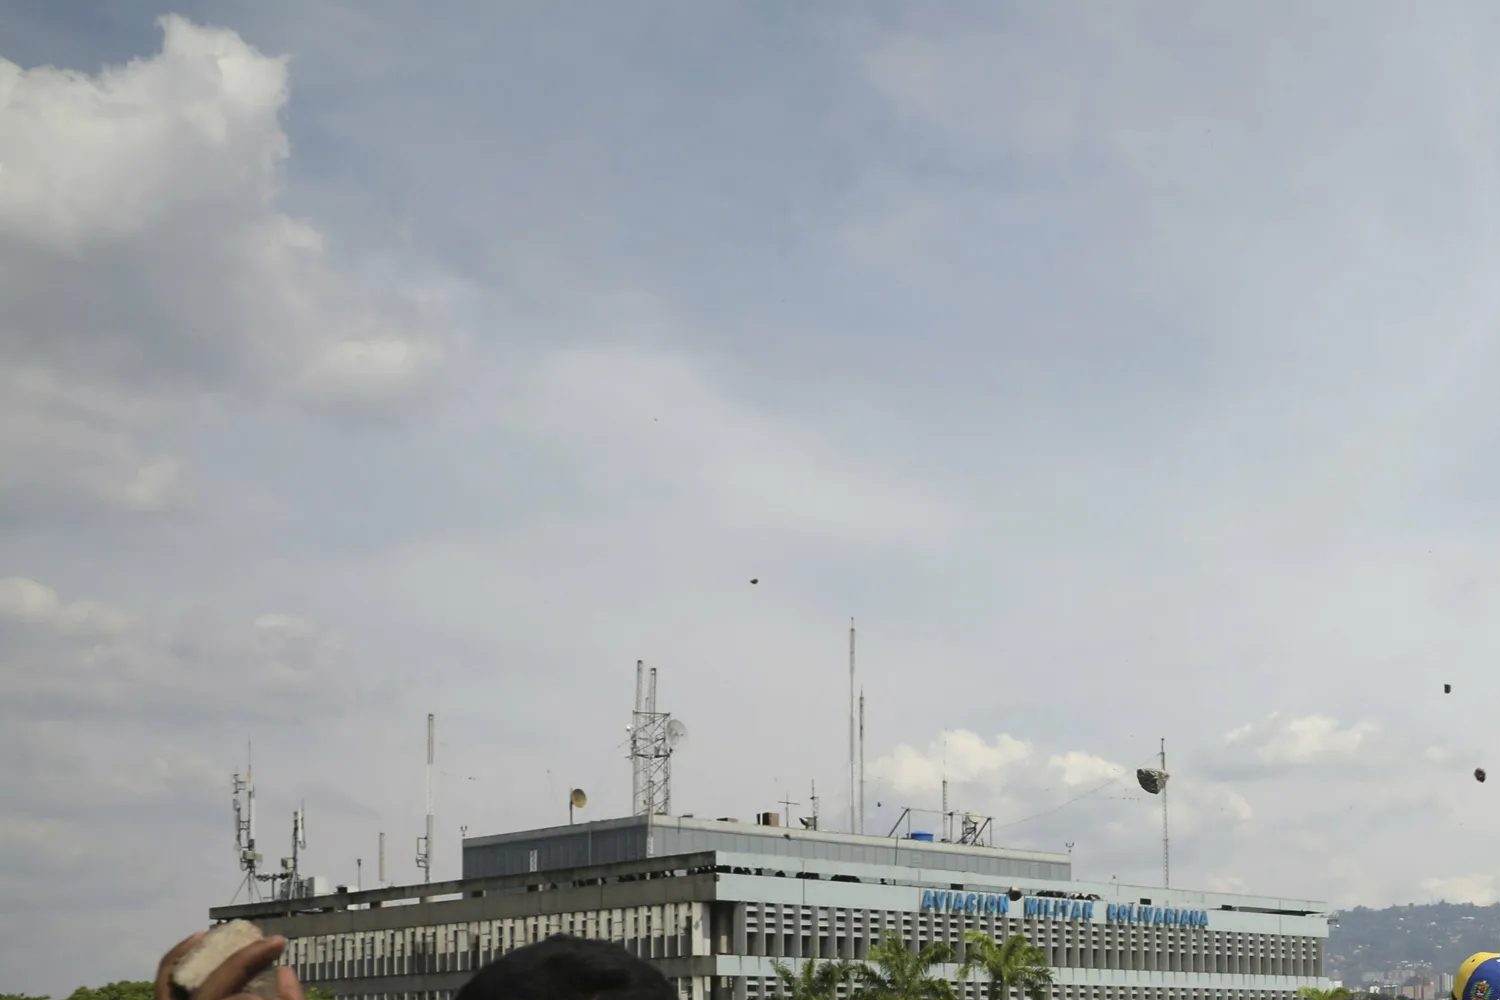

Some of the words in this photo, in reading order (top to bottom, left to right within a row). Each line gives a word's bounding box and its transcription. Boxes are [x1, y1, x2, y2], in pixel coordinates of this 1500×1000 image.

[922, 889, 1009, 913] AVIACION
[1024, 898, 1094, 920] MILITAR
[1107, 903, 1208, 926] BOLIVARIANA
